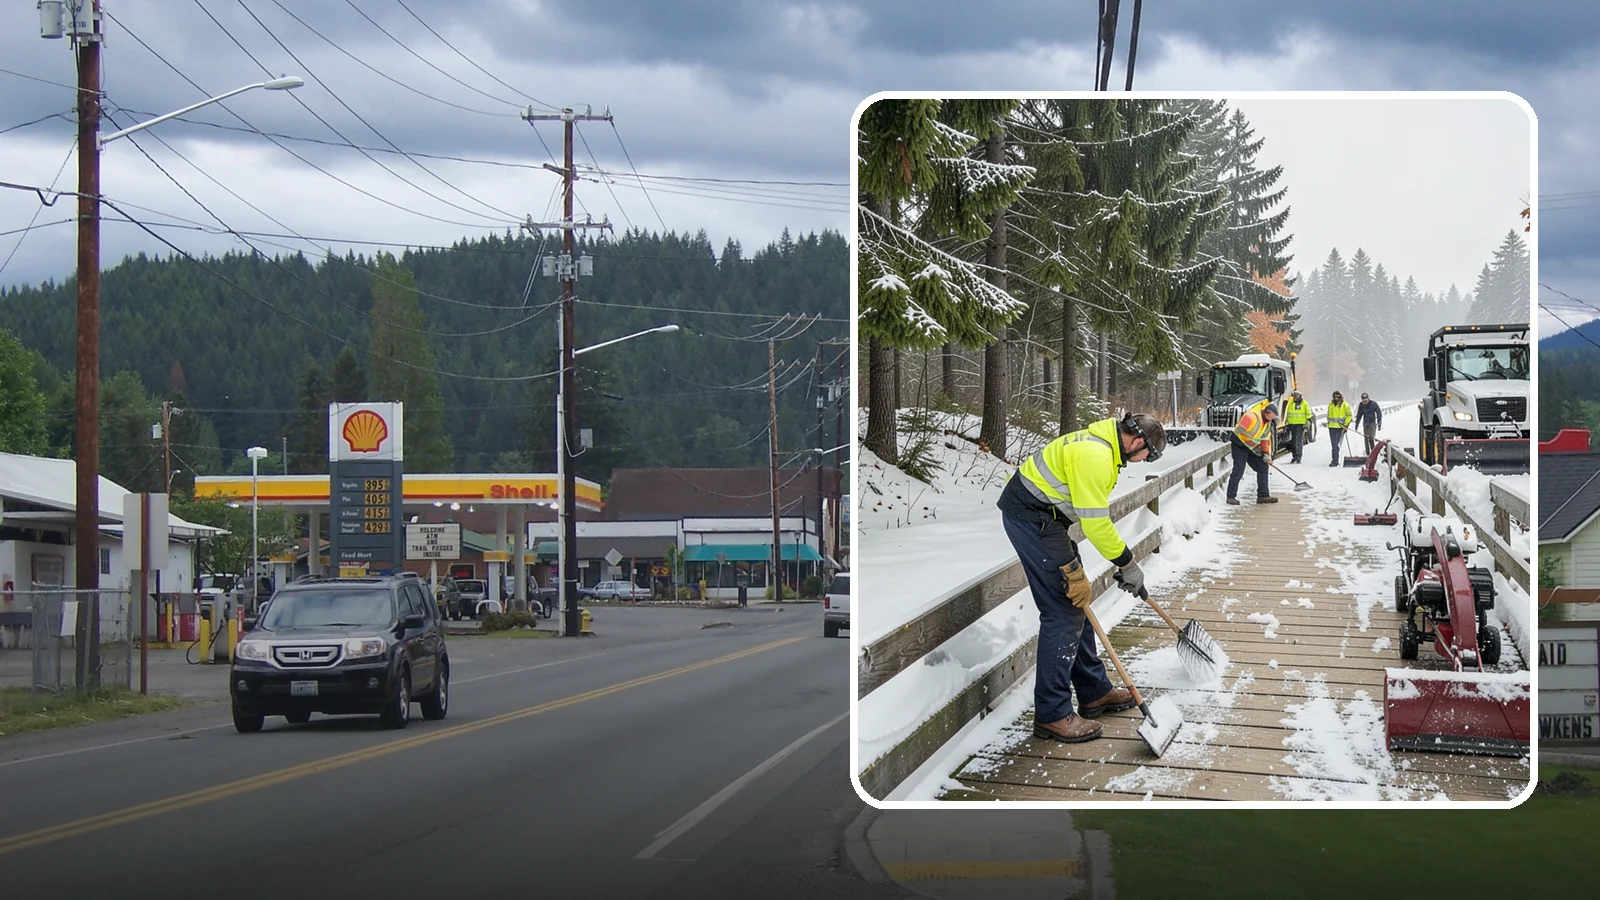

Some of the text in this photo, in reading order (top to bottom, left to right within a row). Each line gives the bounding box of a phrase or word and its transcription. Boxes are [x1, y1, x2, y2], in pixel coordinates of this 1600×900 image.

[366, 480, 384, 490] 395
[490, 484, 547, 499] Shell
[366, 494, 383, 504] 405
[366, 508, 383, 518] 415
[366, 522, 383, 532] 429
